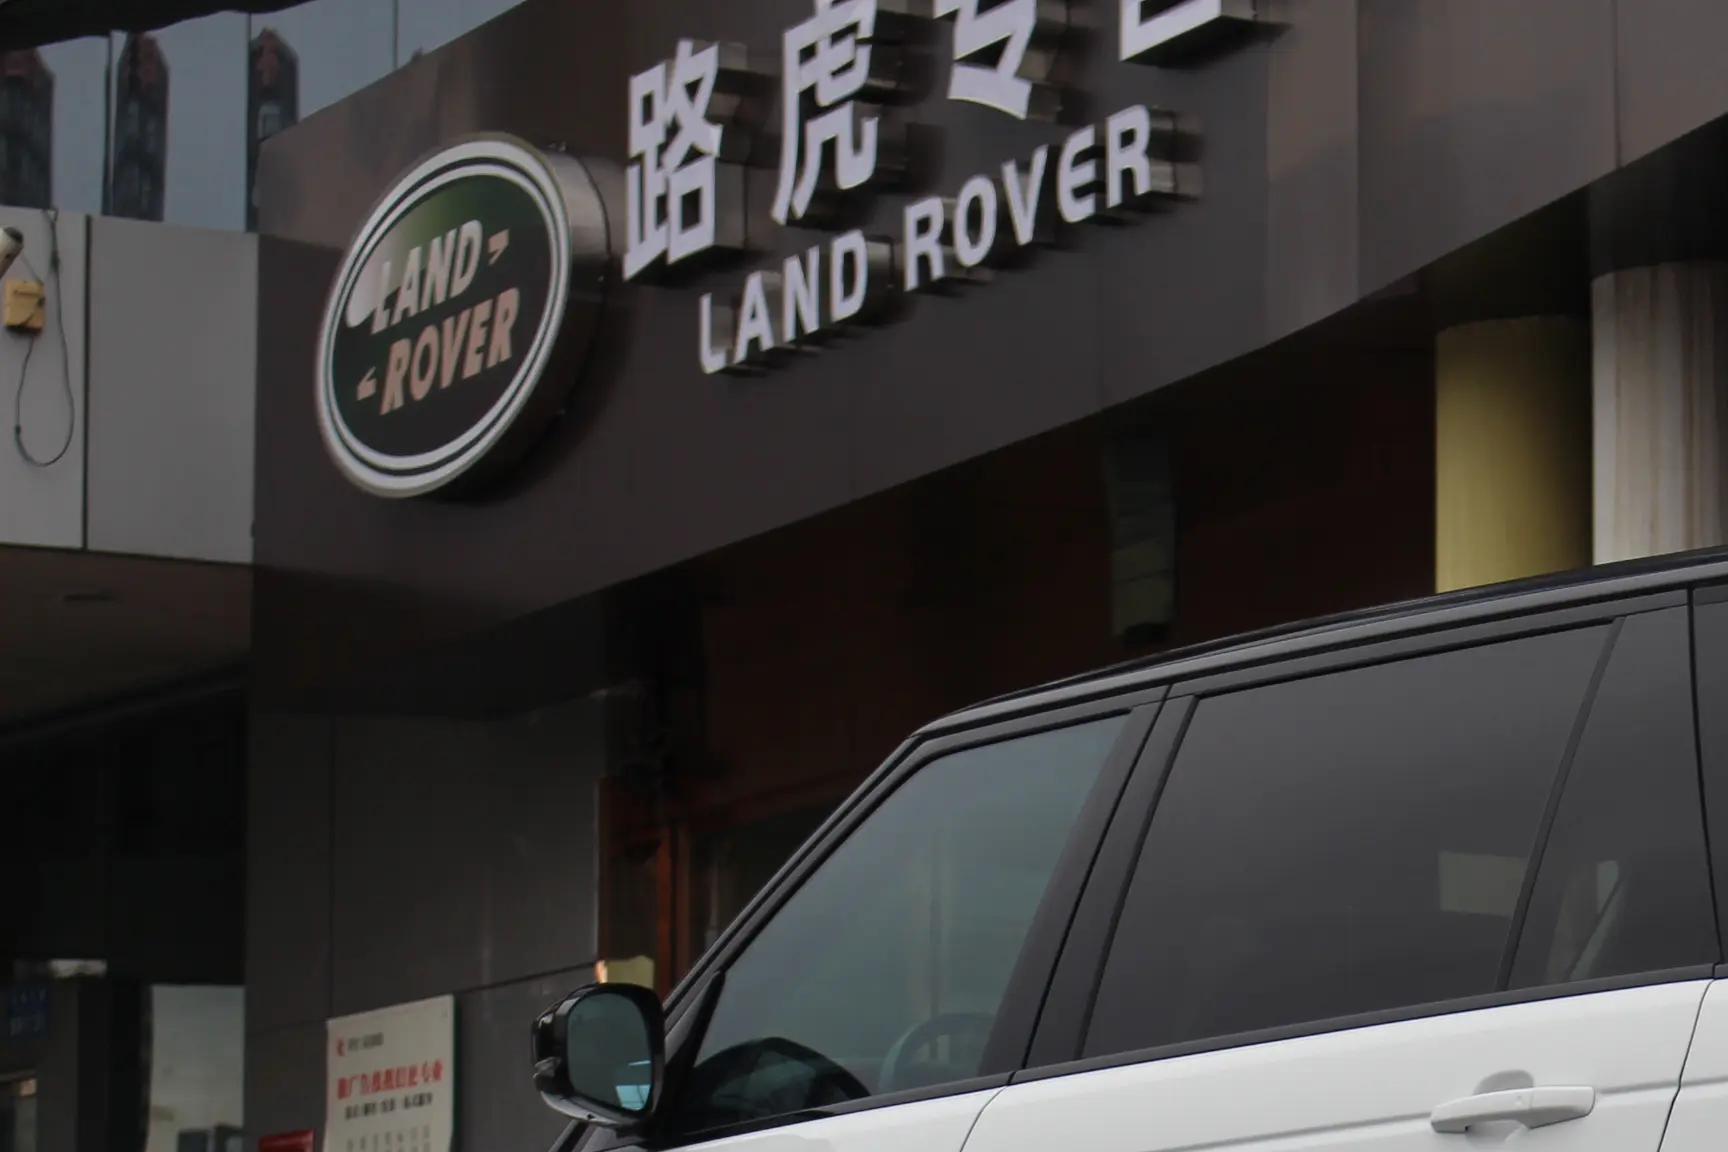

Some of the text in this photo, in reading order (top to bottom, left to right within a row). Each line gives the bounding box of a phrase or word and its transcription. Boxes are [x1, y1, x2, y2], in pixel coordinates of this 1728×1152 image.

[623, 0, 1222, 281] 路虎专
[700, 104, 1151, 374] LAND ROVER
[371, 219, 483, 335] LAND
[379, 287, 520, 415] ROVER
